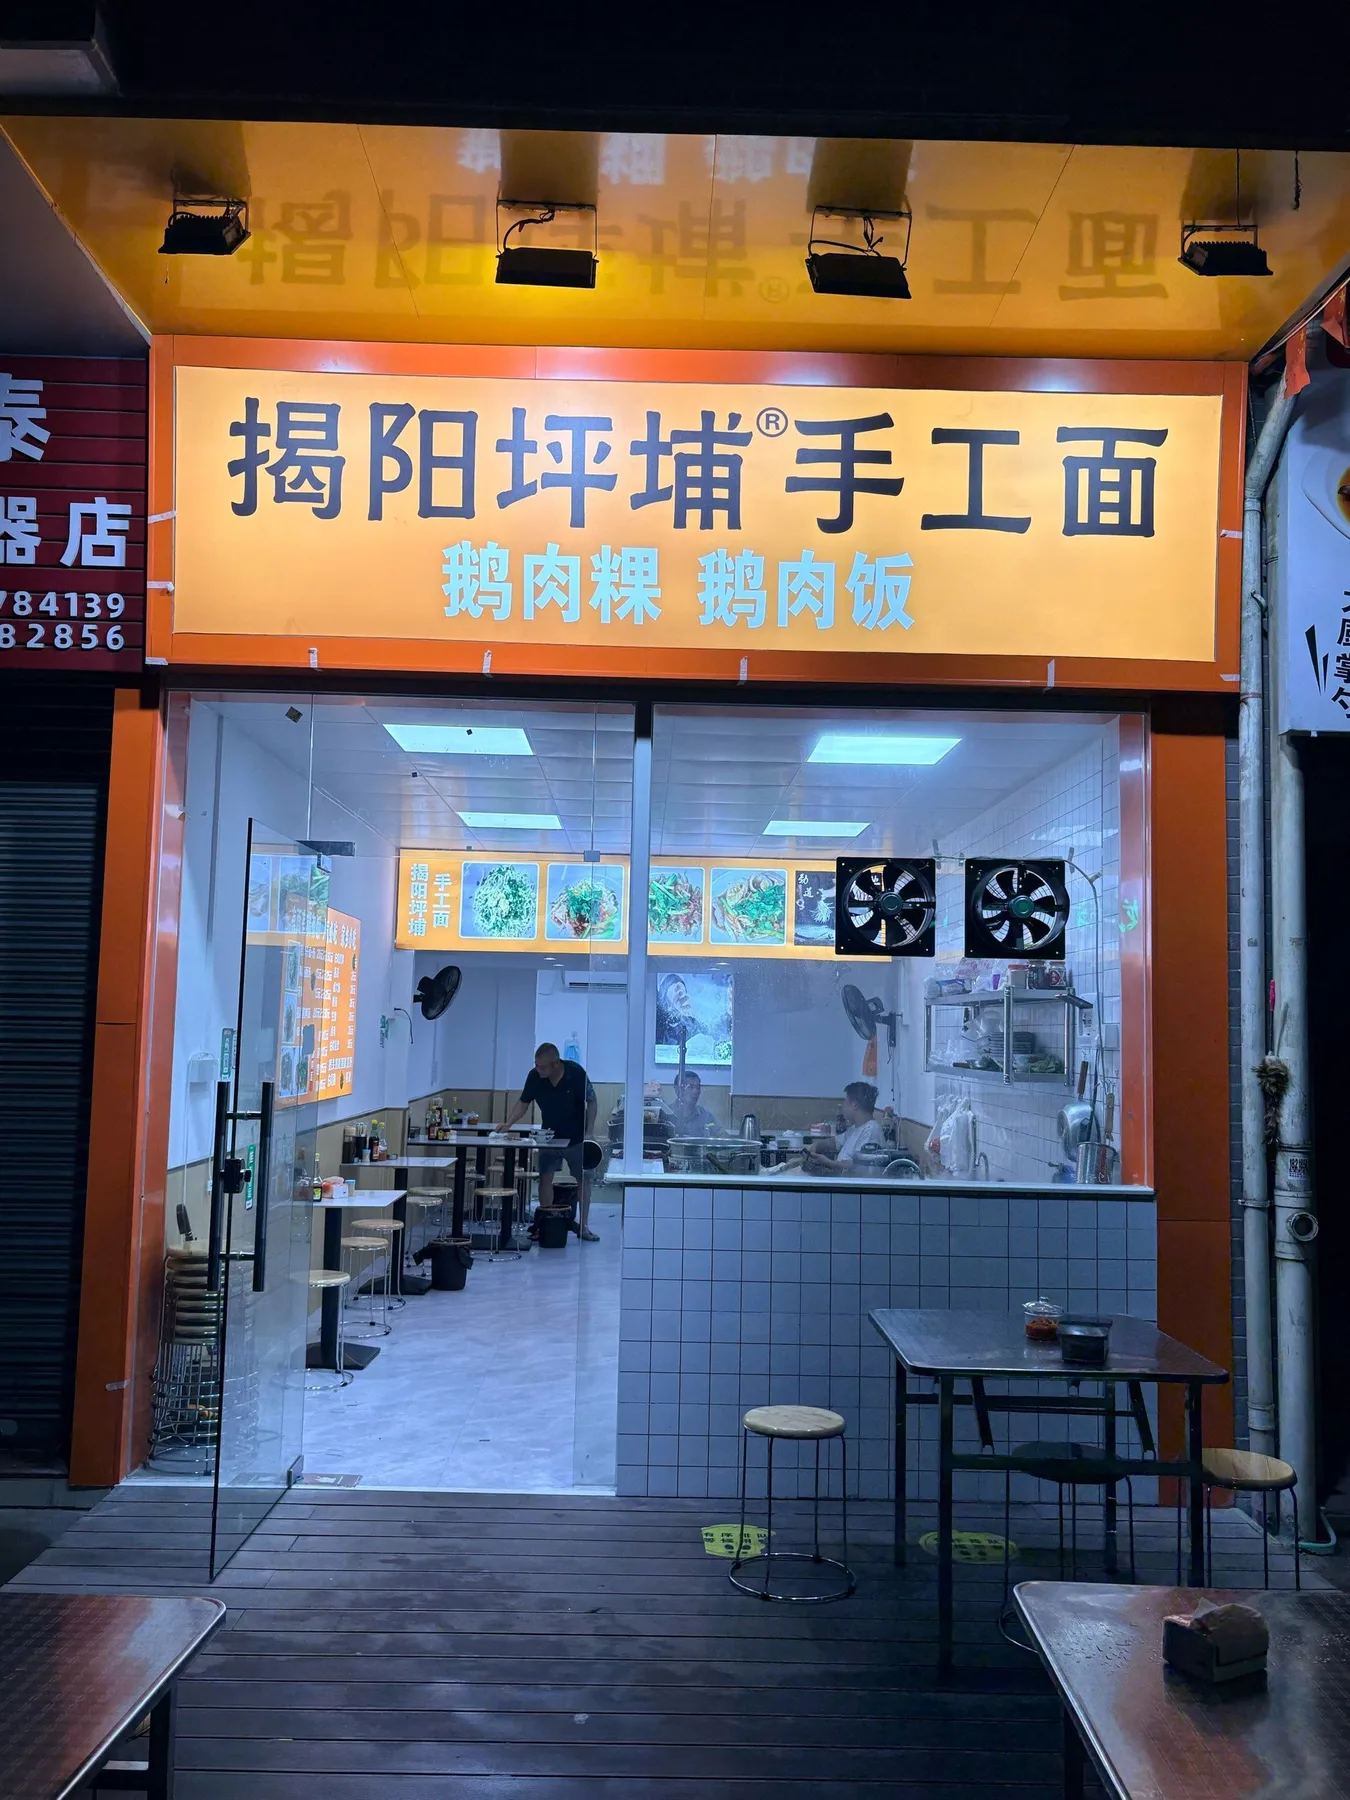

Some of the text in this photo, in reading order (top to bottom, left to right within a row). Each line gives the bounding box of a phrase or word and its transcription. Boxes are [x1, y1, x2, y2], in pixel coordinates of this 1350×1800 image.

[442, 541, 662, 625] 鹅肉粿
[697, 548, 915, 630] 鹅肉饭
[0, 624, 125, 650] 82856
[408, 863, 430, 937] 揭阳坪埔
[432, 873, 453, 929] 手工面
